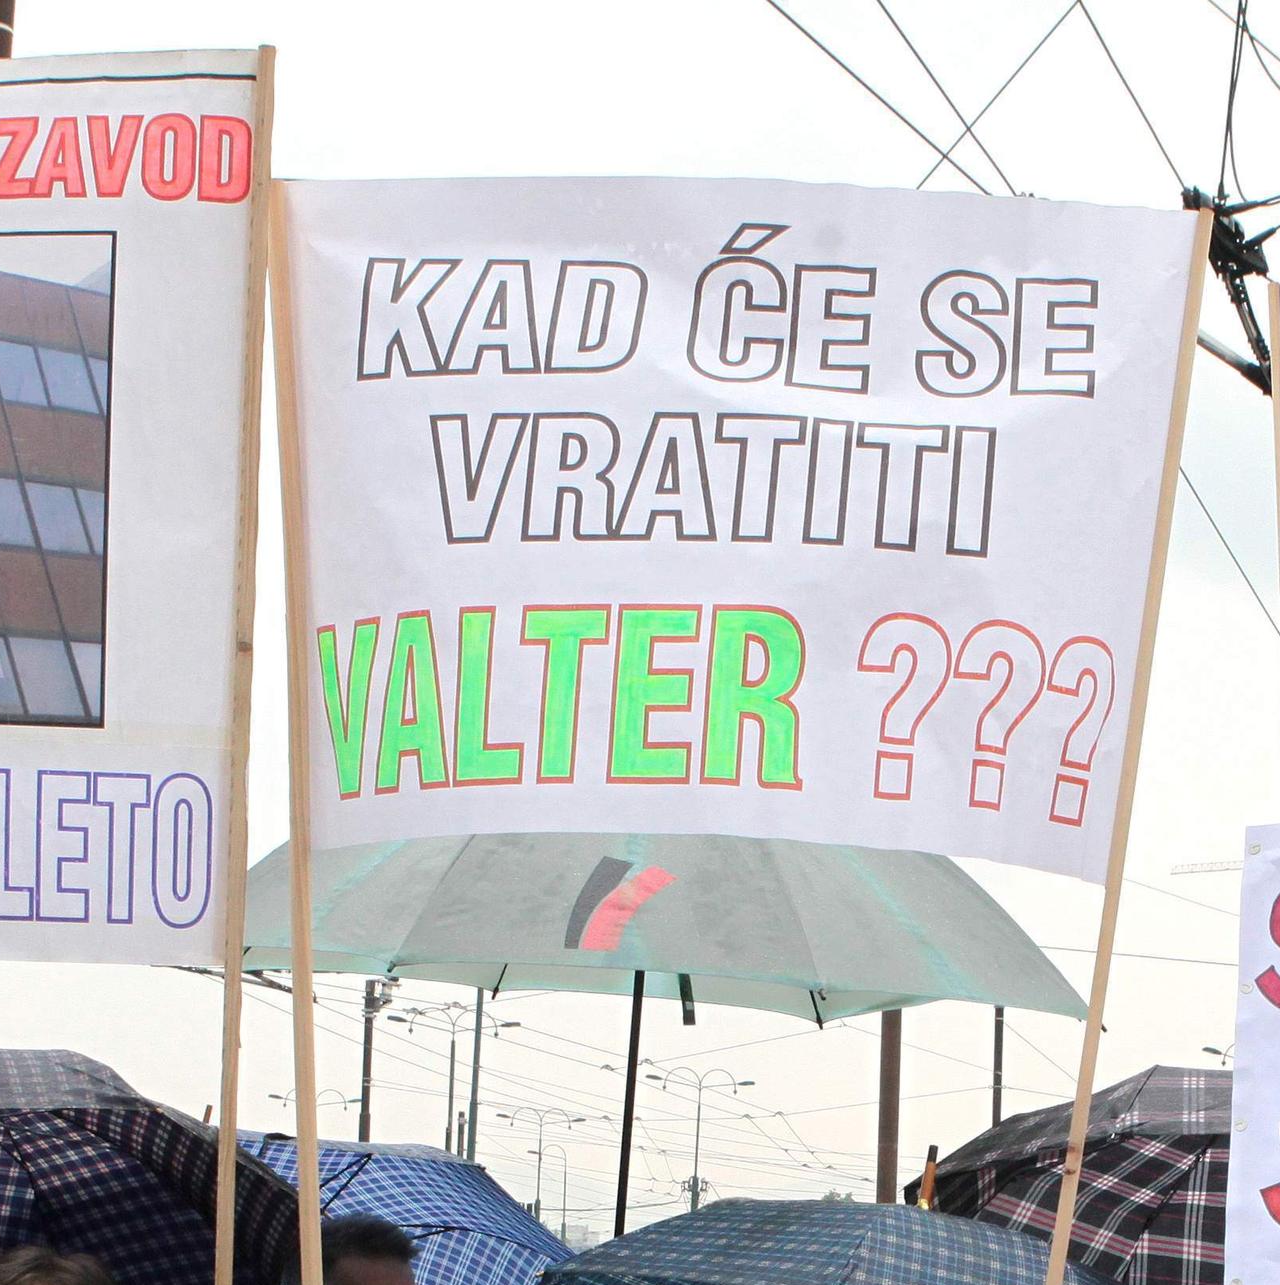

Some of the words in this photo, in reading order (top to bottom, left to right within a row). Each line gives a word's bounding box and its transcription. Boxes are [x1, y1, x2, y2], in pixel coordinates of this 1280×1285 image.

[357, 257, 648, 382] KAD
[686, 223, 876, 394] ĆE
[915, 269, 1099, 398] SE
[430, 413, 997, 558] VRATITI
[317, 603, 807, 800] VALTER
[857, 613, 1115, 828] ???
